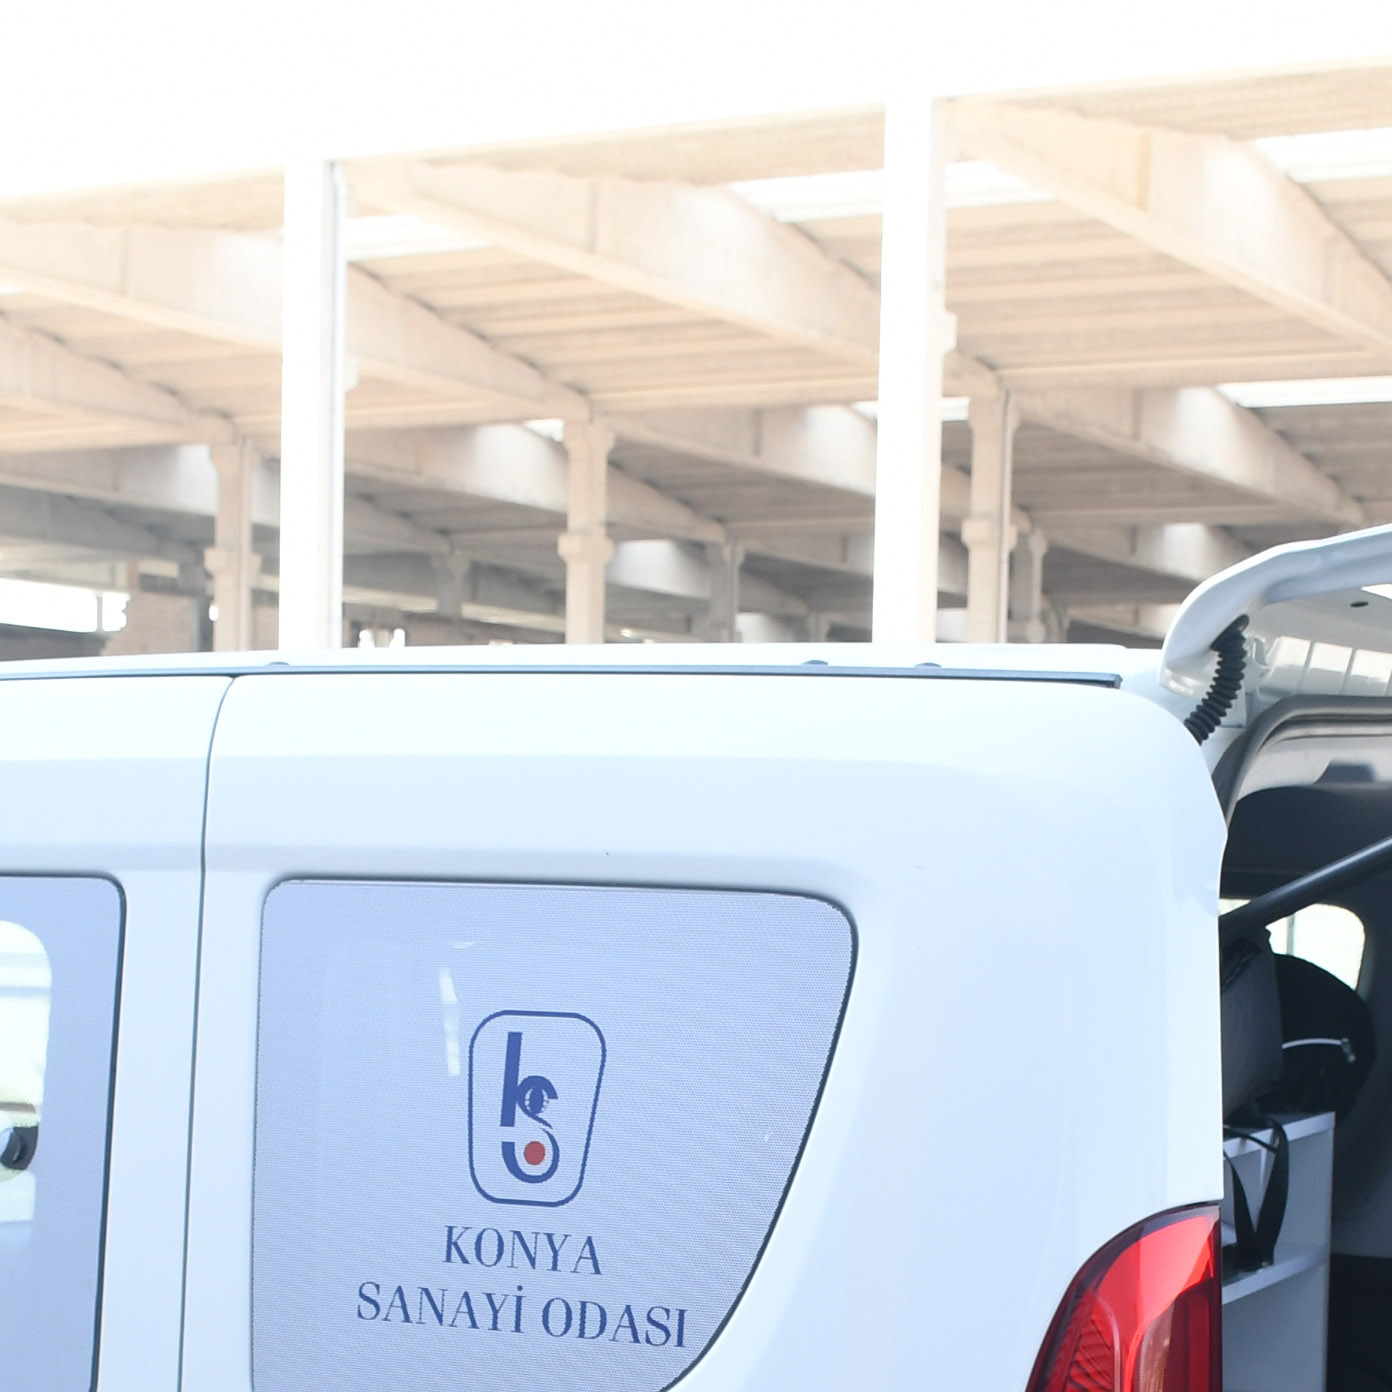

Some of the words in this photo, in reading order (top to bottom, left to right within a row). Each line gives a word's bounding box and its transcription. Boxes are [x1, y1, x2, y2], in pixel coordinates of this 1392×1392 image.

[442, 1224, 602, 1276] KONYA
[356, 1281, 525, 1334] SANAYİ
[541, 1297, 688, 1349] ODASI
